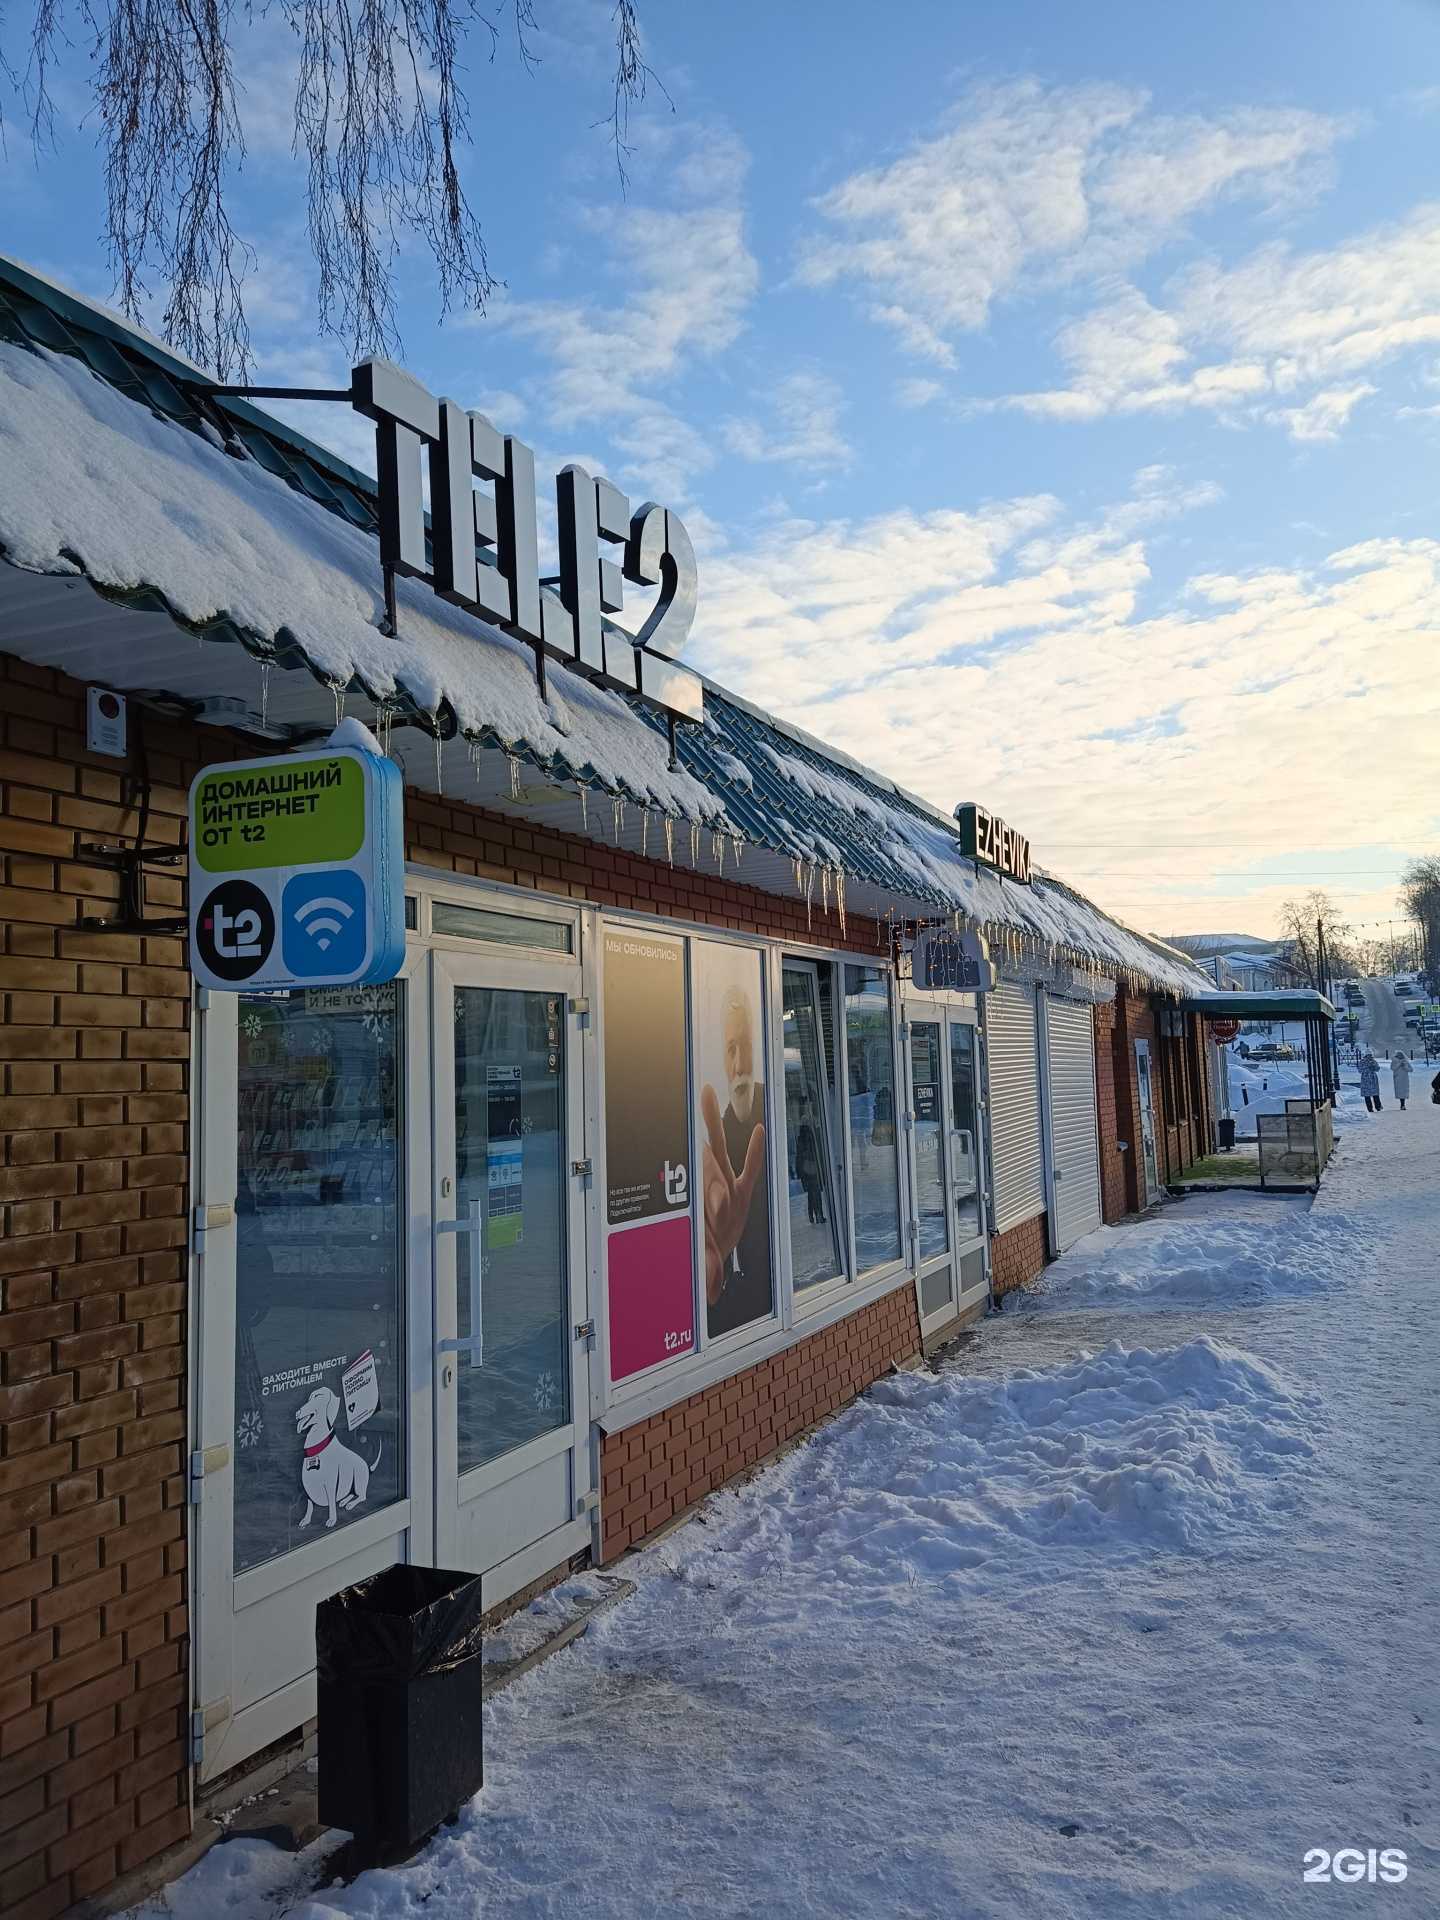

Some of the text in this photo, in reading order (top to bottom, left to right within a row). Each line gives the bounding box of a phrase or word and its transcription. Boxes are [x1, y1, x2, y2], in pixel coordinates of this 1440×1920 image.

[353, 360, 704, 723] TELE2
[201, 763, 342, 805] ДОМАШНИЙ
[202, 793, 320, 824] ИНТЕРНЕТ
[202, 824, 265, 847] ОТ t2
[975, 806, 1033, 884] EZHEVIKA
[204, 904, 262, 959] t2
[606, 940, 677, 960] МЫ ОБНОВИЛИСЬ
[323, 995, 341, 1007] НЕ
[657, 1160, 687, 1204] t2
[664, 1328, 692, 1350] t2.ru
[262, 1355, 347, 1386] ЗАХОДИТЕ ВМЕСТЕ
[262, 1372, 323, 1396] С ПИТОМЦЕМ
